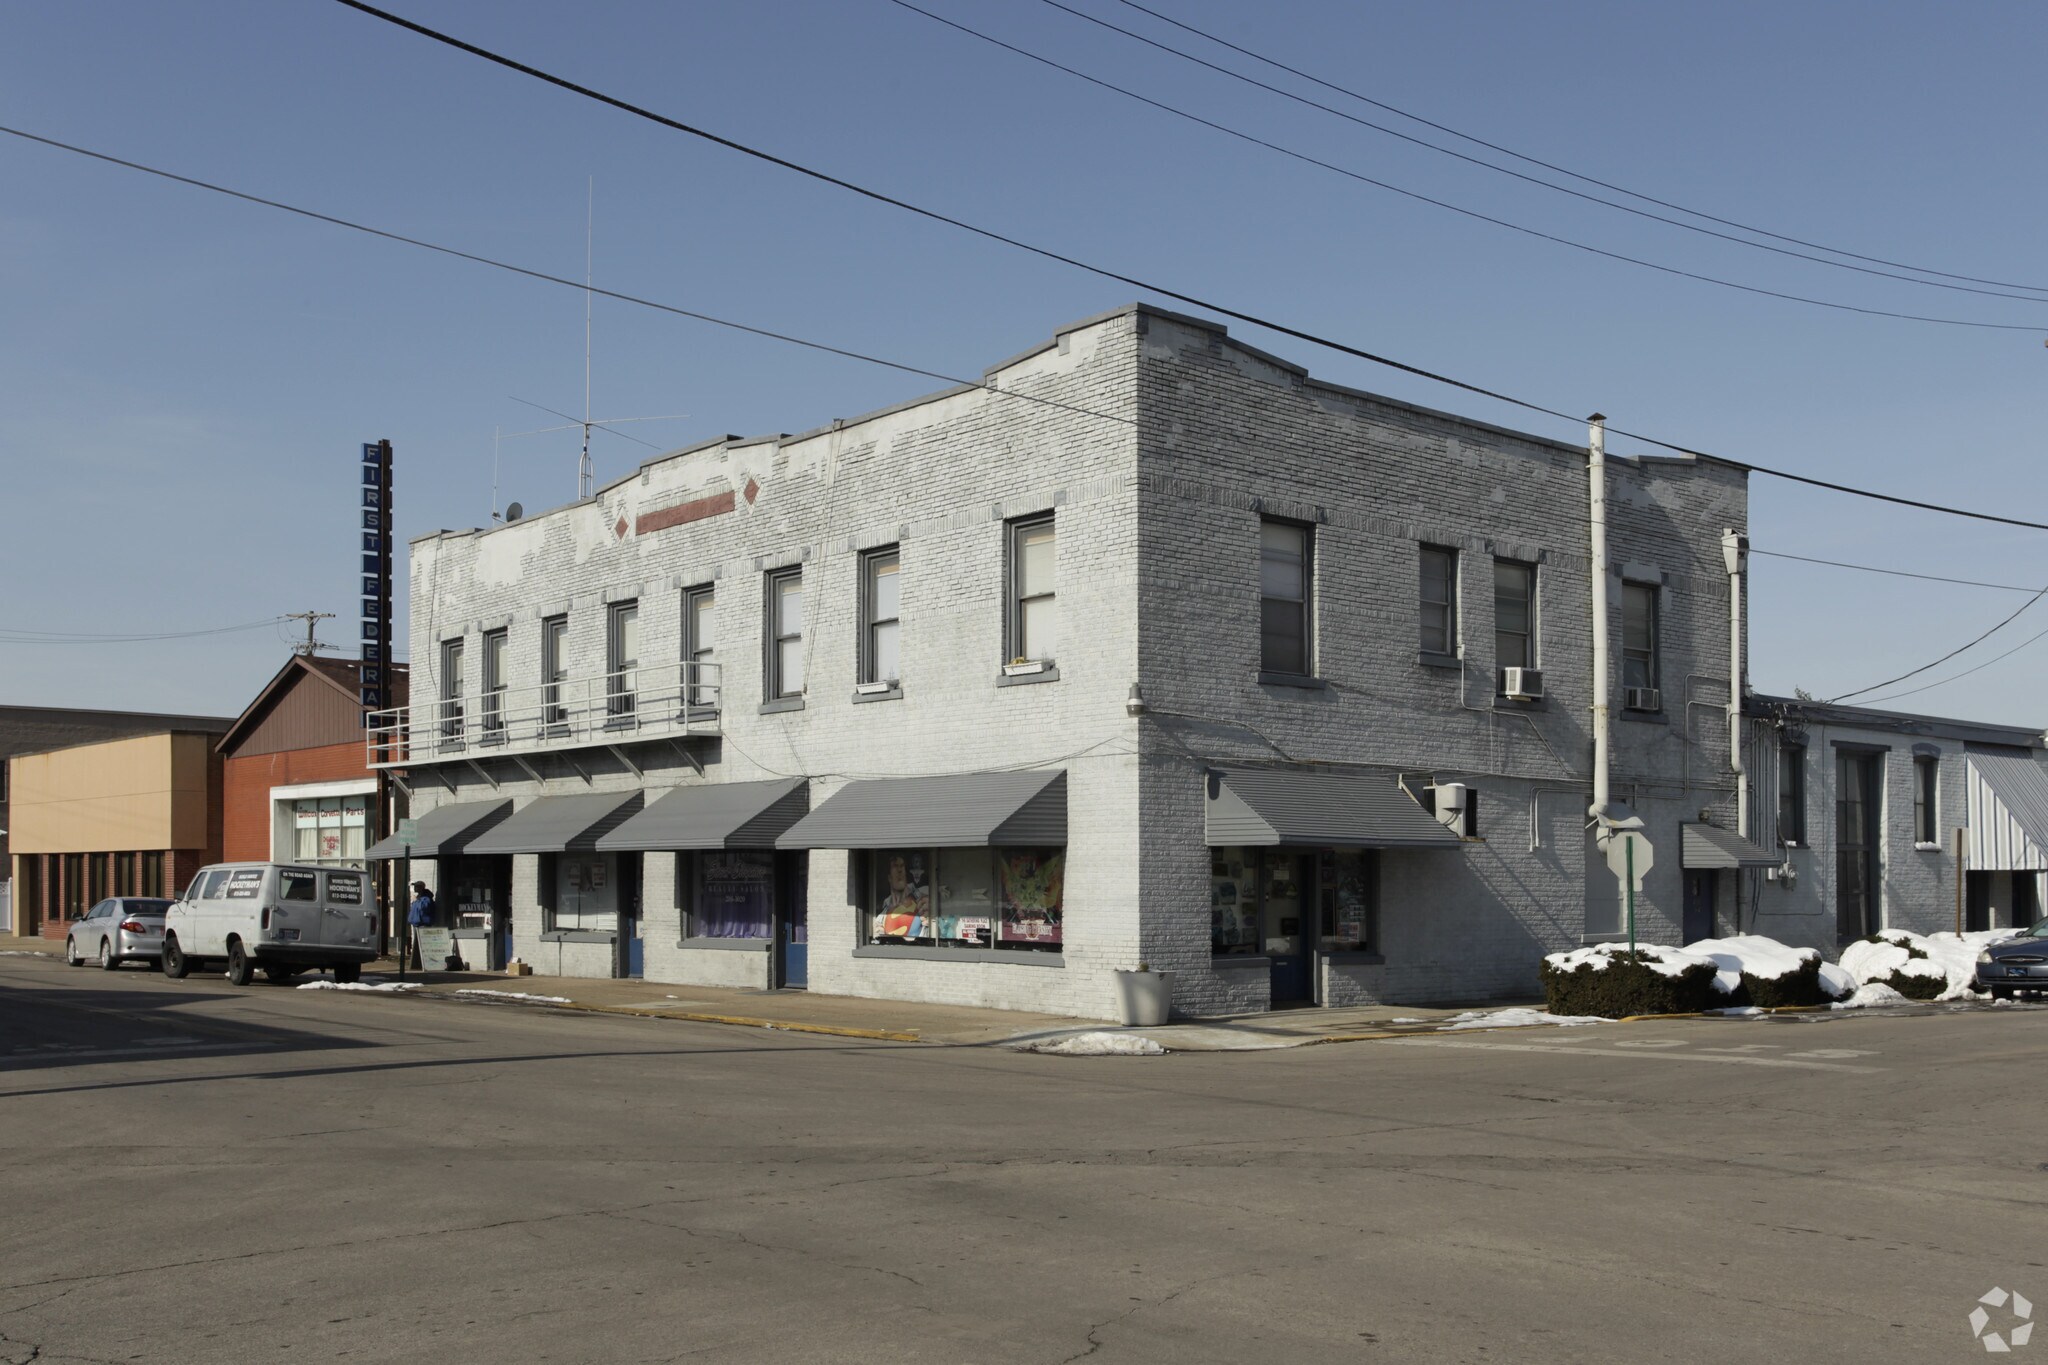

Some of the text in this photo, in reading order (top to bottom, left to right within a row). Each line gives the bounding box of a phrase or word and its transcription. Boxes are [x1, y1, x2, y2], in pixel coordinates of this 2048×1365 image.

[366, 447, 379, 549] FIRST
[345, 807, 364, 816] Parts
[329, 884, 360, 893] HOCKEYMAN'S
